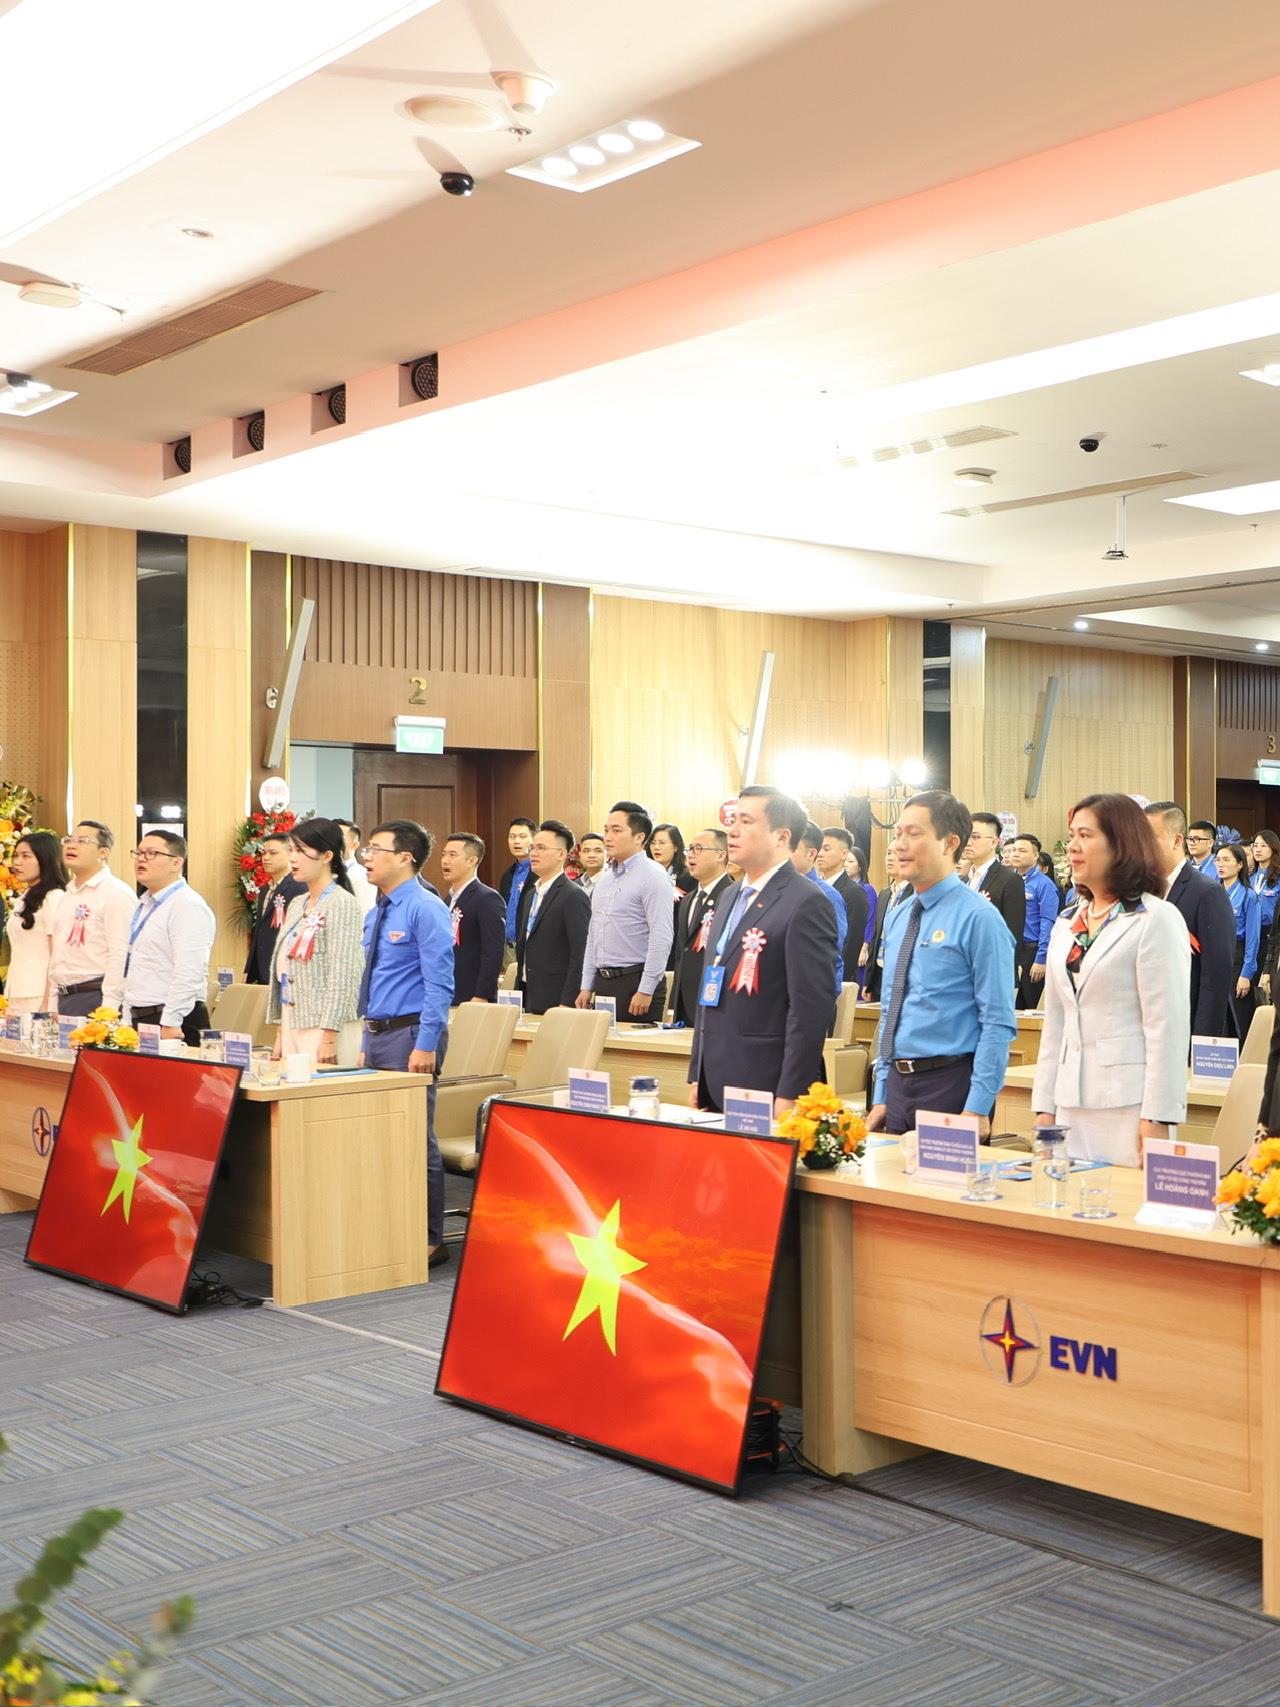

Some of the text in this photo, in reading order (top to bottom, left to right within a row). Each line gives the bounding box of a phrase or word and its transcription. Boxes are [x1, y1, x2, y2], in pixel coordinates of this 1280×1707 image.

[408, 677, 427, 704] 2
[1267, 735, 1276, 754] 3
[1155, 1181, 1164, 1191] LÊ
[1050, 1336, 1118, 1382] EVN
